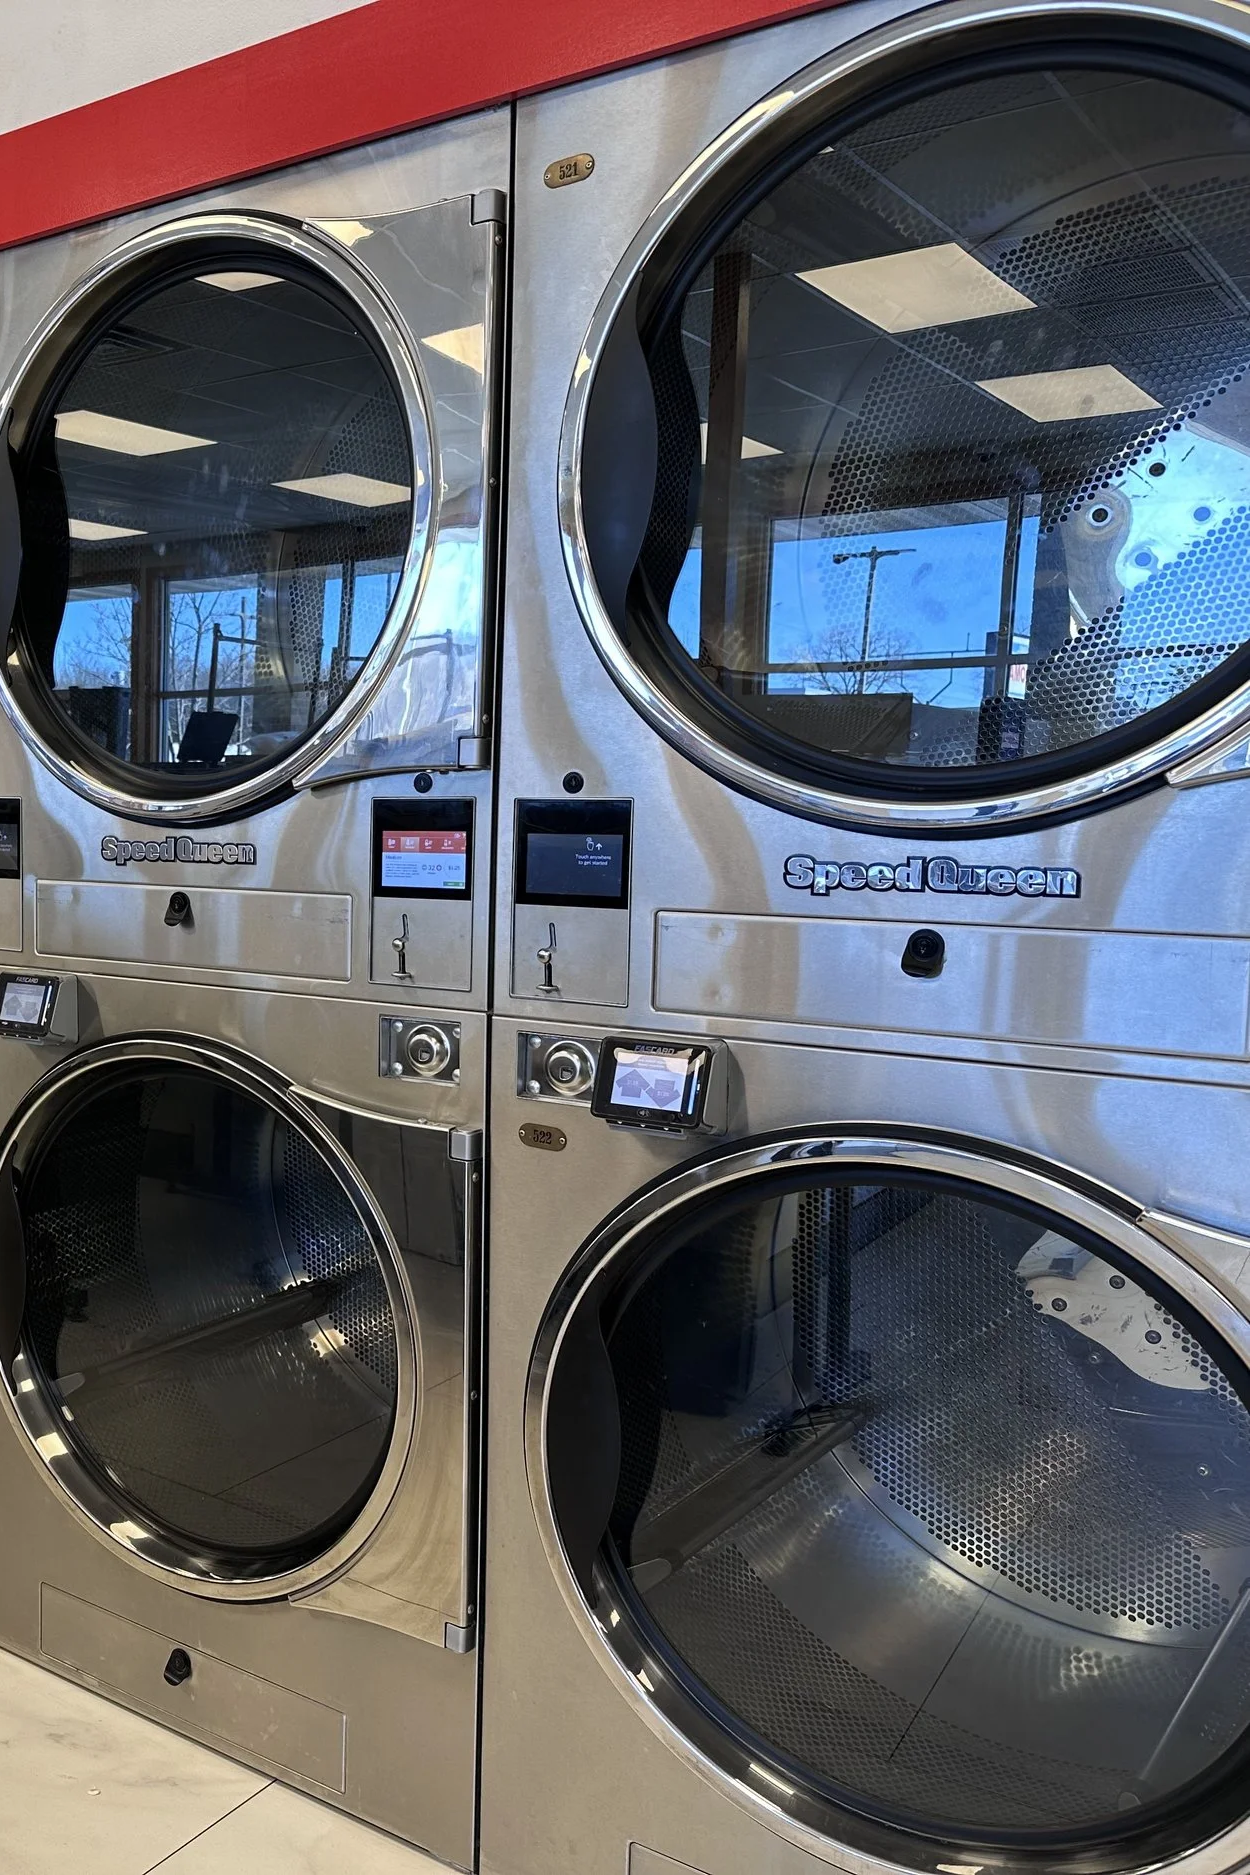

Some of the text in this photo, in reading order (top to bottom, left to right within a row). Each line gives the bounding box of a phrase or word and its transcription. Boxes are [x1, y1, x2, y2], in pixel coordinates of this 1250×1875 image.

[558, 161, 579, 181] 521
[101, 835, 258, 866] Speed Queen
[589, 853, 612, 861] anywhere
[784, 854, 1081, 898] Speed Queen
[634, 1044, 675, 1055] FASCARD
[532, 1129, 552, 1145] 522
